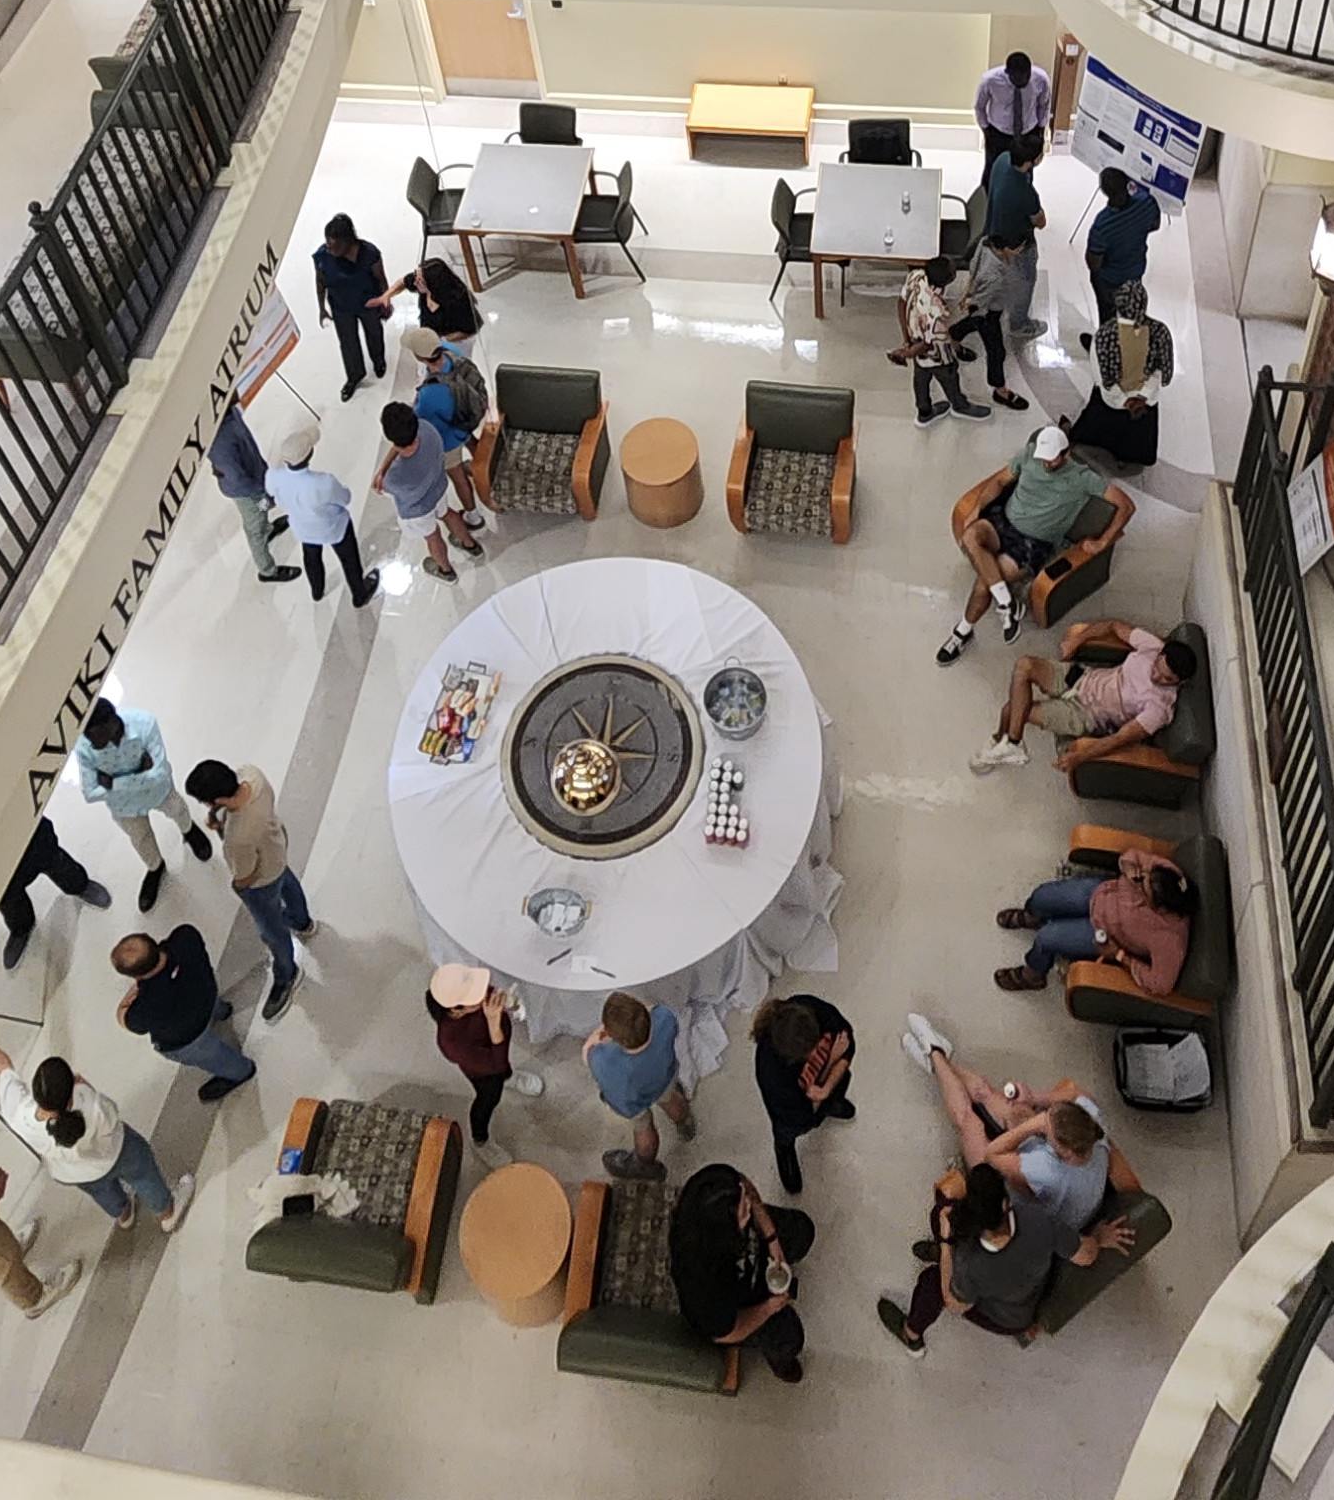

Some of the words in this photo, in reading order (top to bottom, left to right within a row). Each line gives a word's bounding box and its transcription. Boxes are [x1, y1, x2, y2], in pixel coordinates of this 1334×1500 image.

[28, 623, 118, 818] AVIKI
[110, 413, 206, 630] FAMILY
[210, 239, 279, 424] ATRIUM
